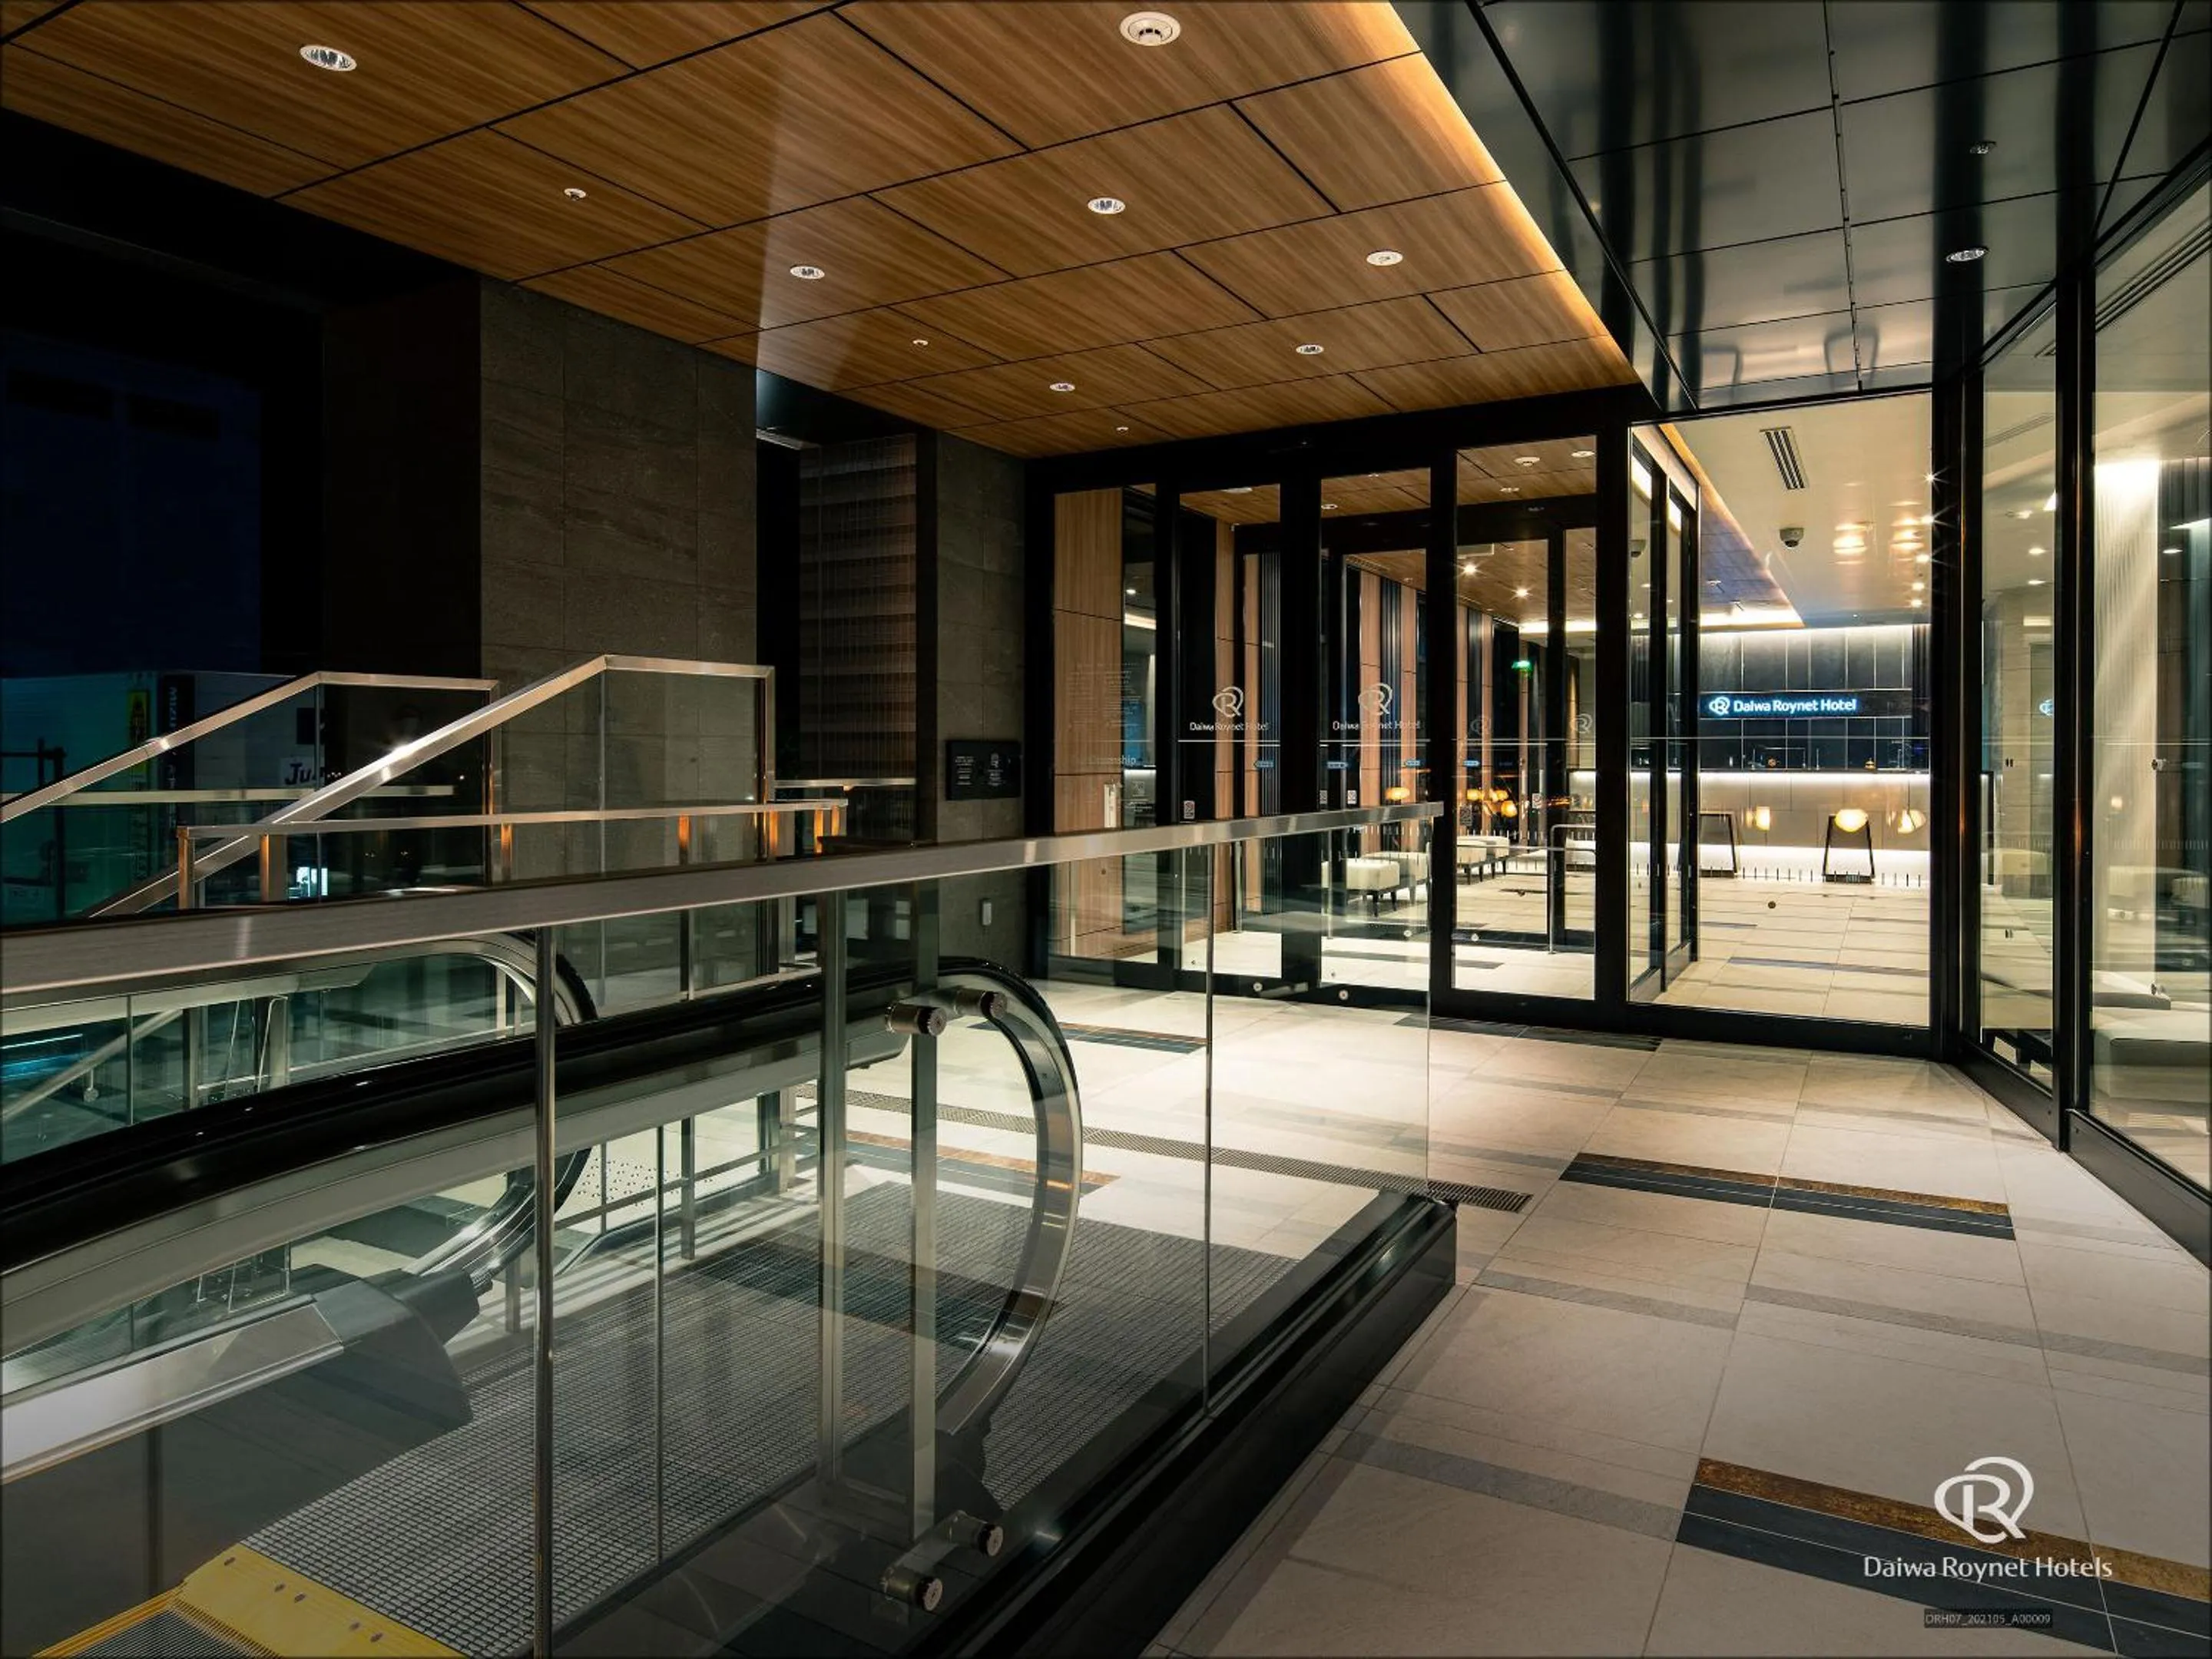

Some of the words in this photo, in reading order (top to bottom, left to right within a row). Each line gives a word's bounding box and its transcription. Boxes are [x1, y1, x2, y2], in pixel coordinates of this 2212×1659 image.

[1734, 700, 1770, 712] Daiwa
[1772, 699, 1819, 714] Roynet
[1820, 698, 1857, 711] Hotel
[1190, 722, 1214, 731] Daiwa
[1333, 720, 1359, 730] Daiwa
